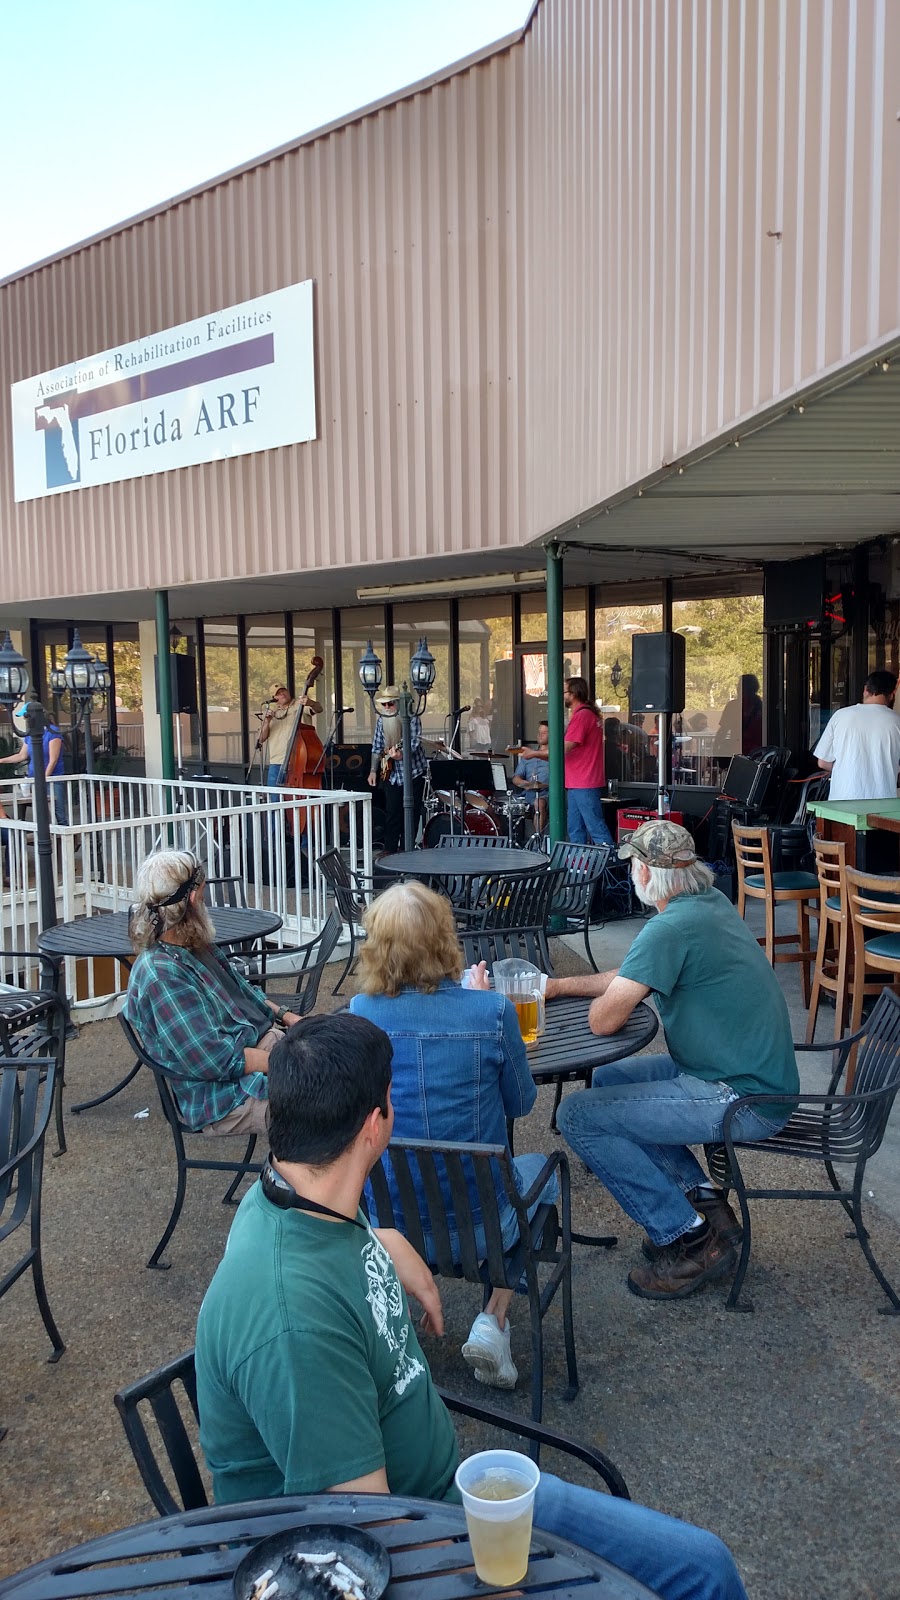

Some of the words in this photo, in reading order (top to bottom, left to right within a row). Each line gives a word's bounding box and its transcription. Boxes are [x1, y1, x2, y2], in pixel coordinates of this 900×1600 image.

[37, 370, 94, 397] Association
[99, 360, 110, 377] of
[114, 334, 201, 372] Rehabilitation
[207, 310, 273, 342] Facilities
[89, 408, 183, 461] Florida
[194, 386, 261, 436] ARF
